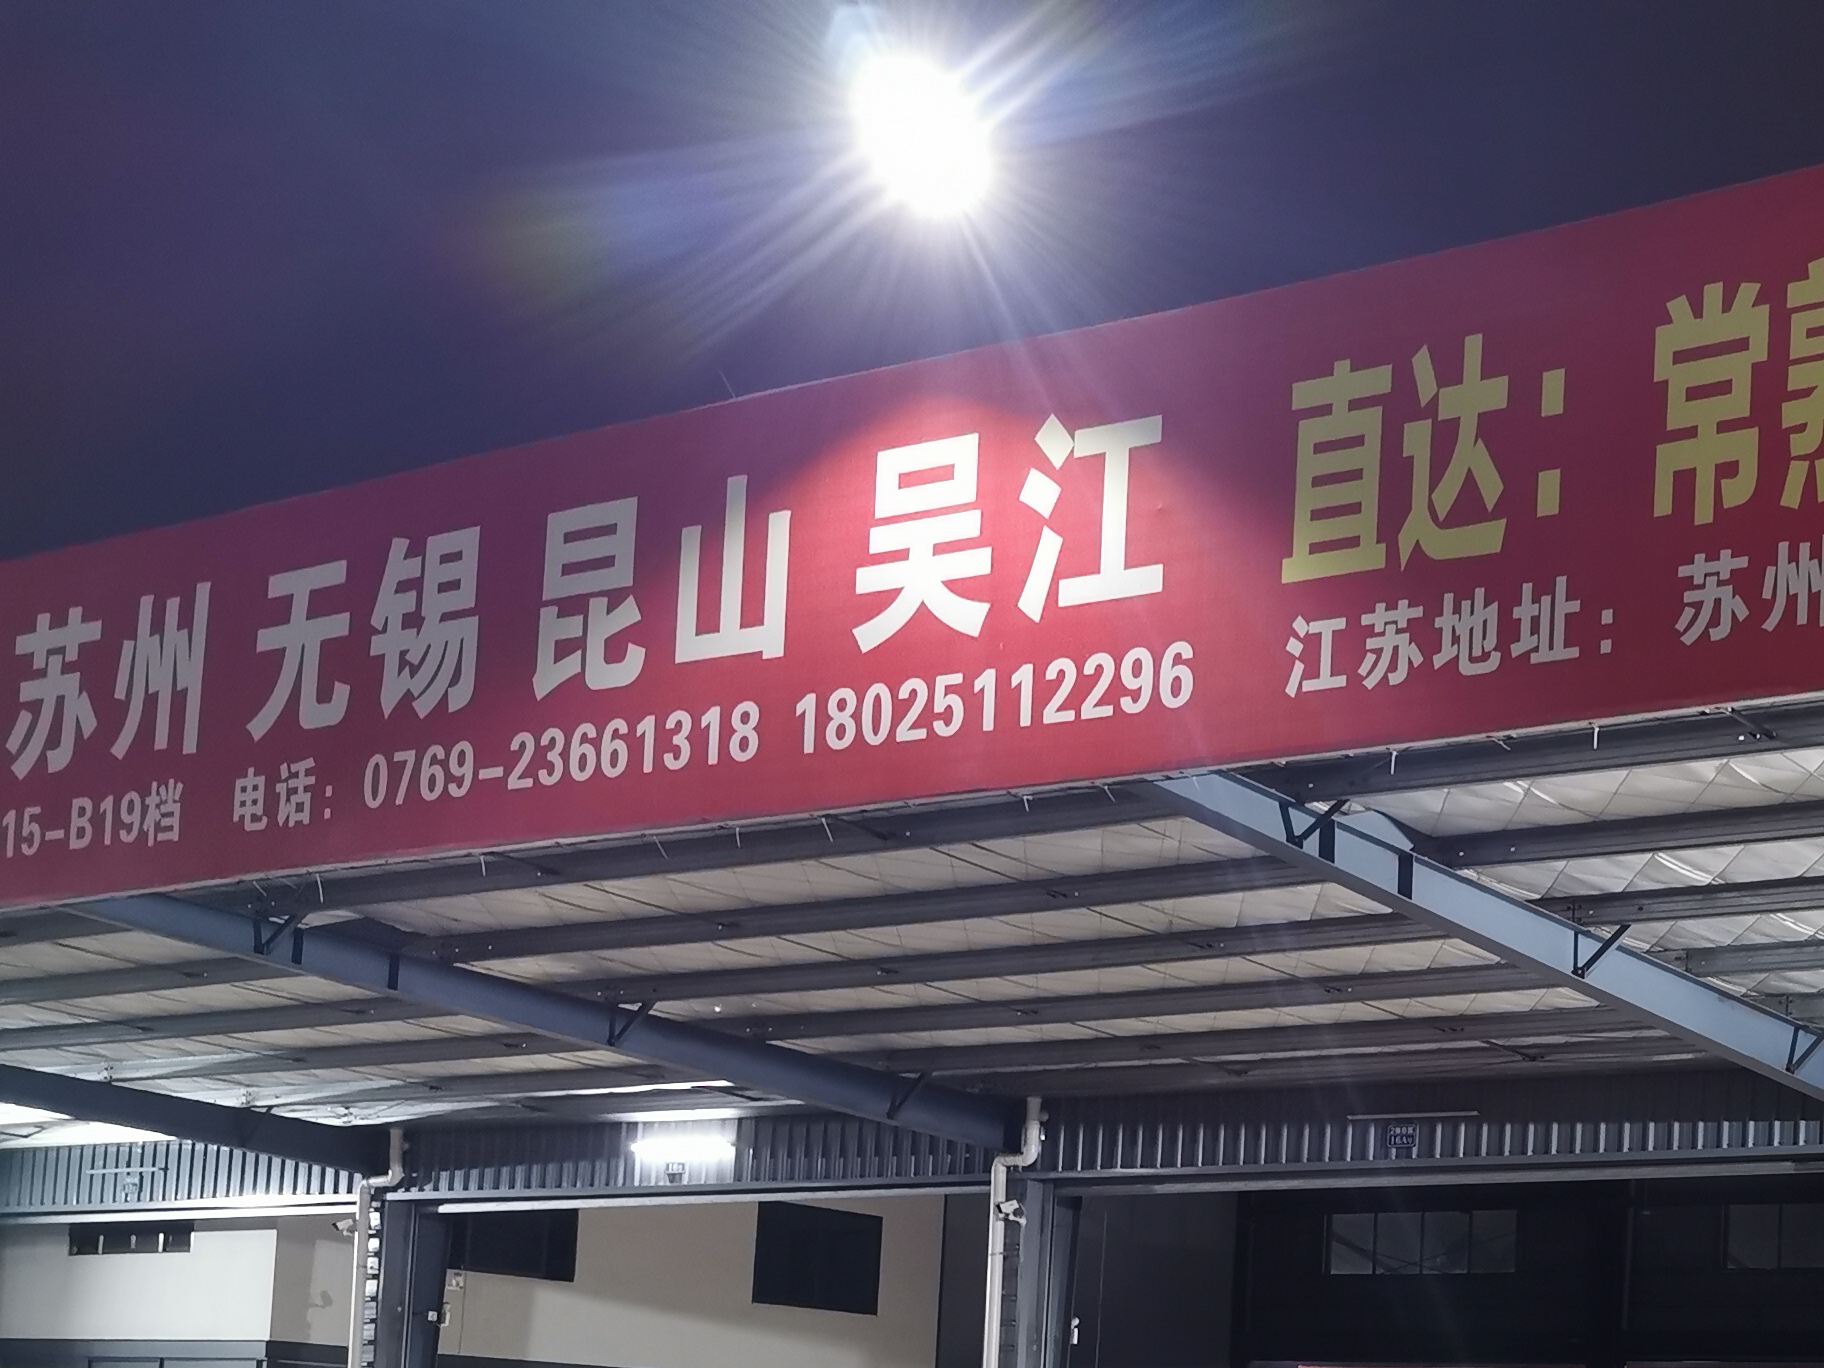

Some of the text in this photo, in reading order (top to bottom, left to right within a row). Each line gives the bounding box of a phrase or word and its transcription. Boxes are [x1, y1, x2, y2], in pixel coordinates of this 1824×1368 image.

[1280, 334, 1566, 583] 直达：
[6, 414, 1165, 780] 苏州 无锡 昆山 吴江
[1285, 576, 1614, 698] 江苏地址：
[2, 640, 1194, 858] 15-B19档 电话： 0769-23661318 18025112296
